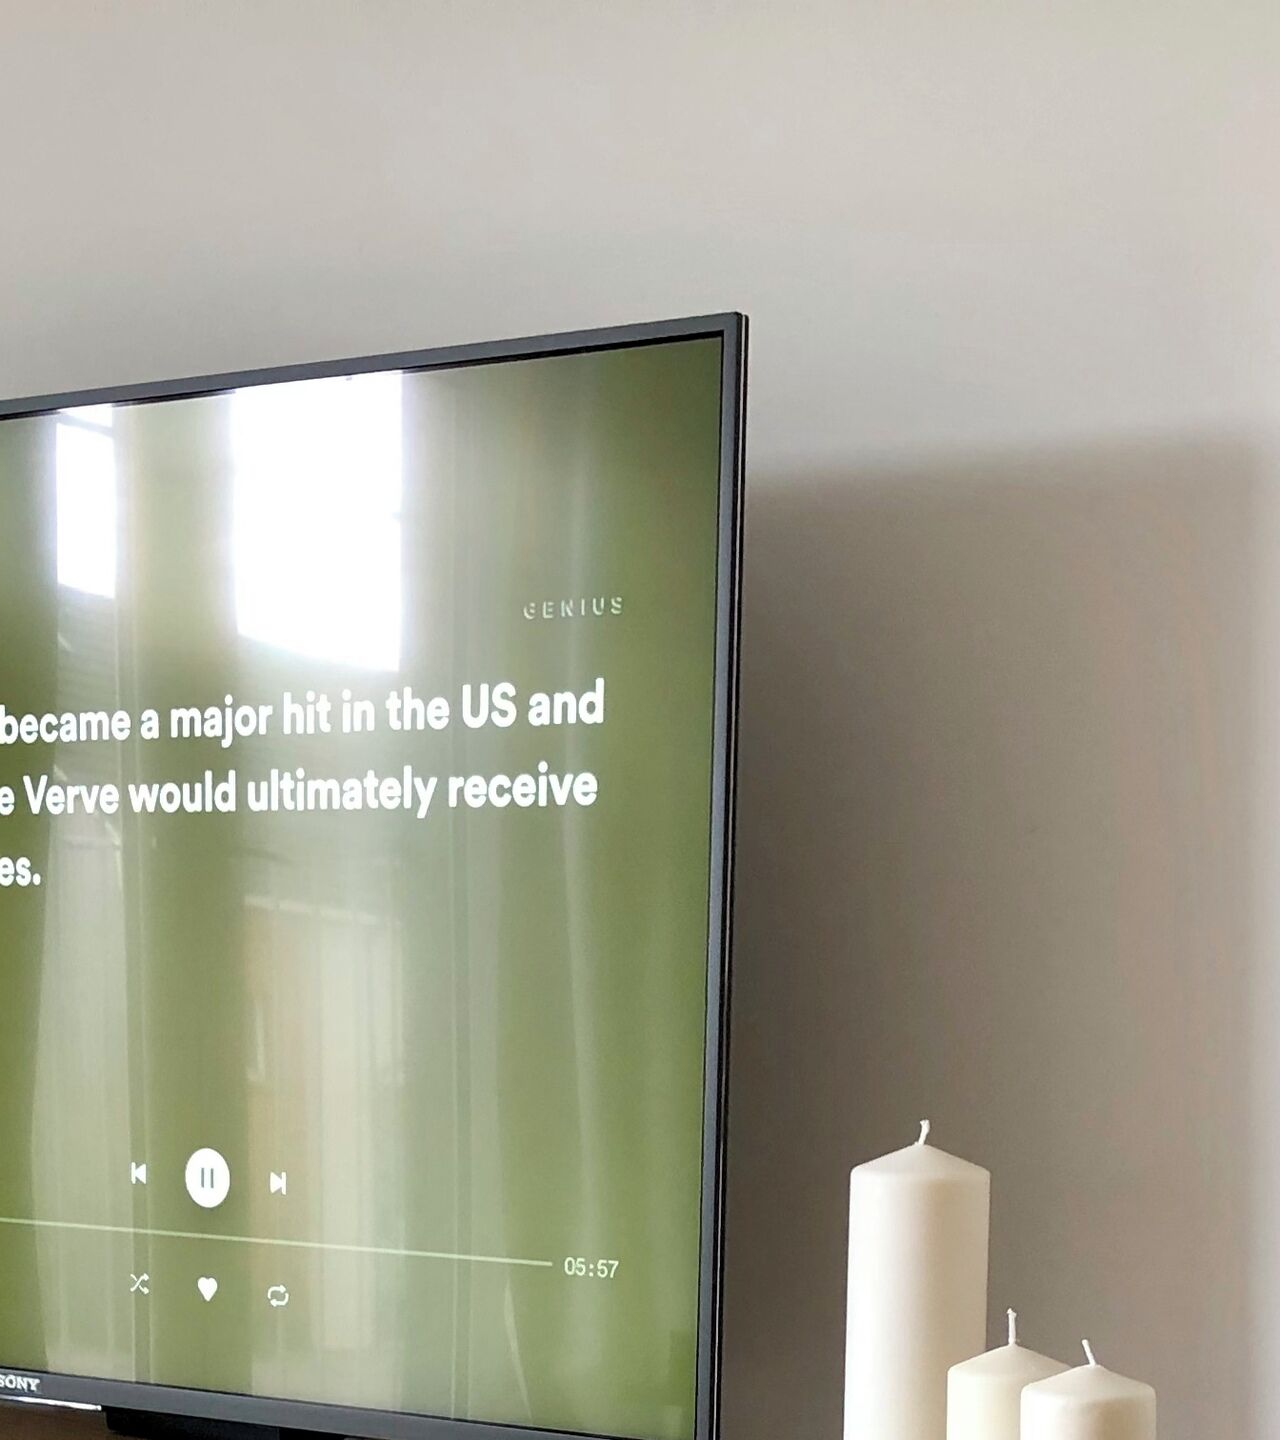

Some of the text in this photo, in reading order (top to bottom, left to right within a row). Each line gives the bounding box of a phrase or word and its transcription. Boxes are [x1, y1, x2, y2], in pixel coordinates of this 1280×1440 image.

[523, 597, 622, 620] GENIUS
[140, 709, 160, 740] a
[170, 694, 274, 748] major
[283, 690, 332, 735] hit
[341, 687, 375, 733] in
[385, 685, 450, 730] the
[462, 682, 517, 729] US
[527, 677, 605, 727] and
[23, 775, 120, 815] Verve
[127, 769, 236, 813] would
[247, 764, 438, 819] ultimately
[448, 760, 598, 808] receive
[564, 1256, 619, 1278] 05:57
